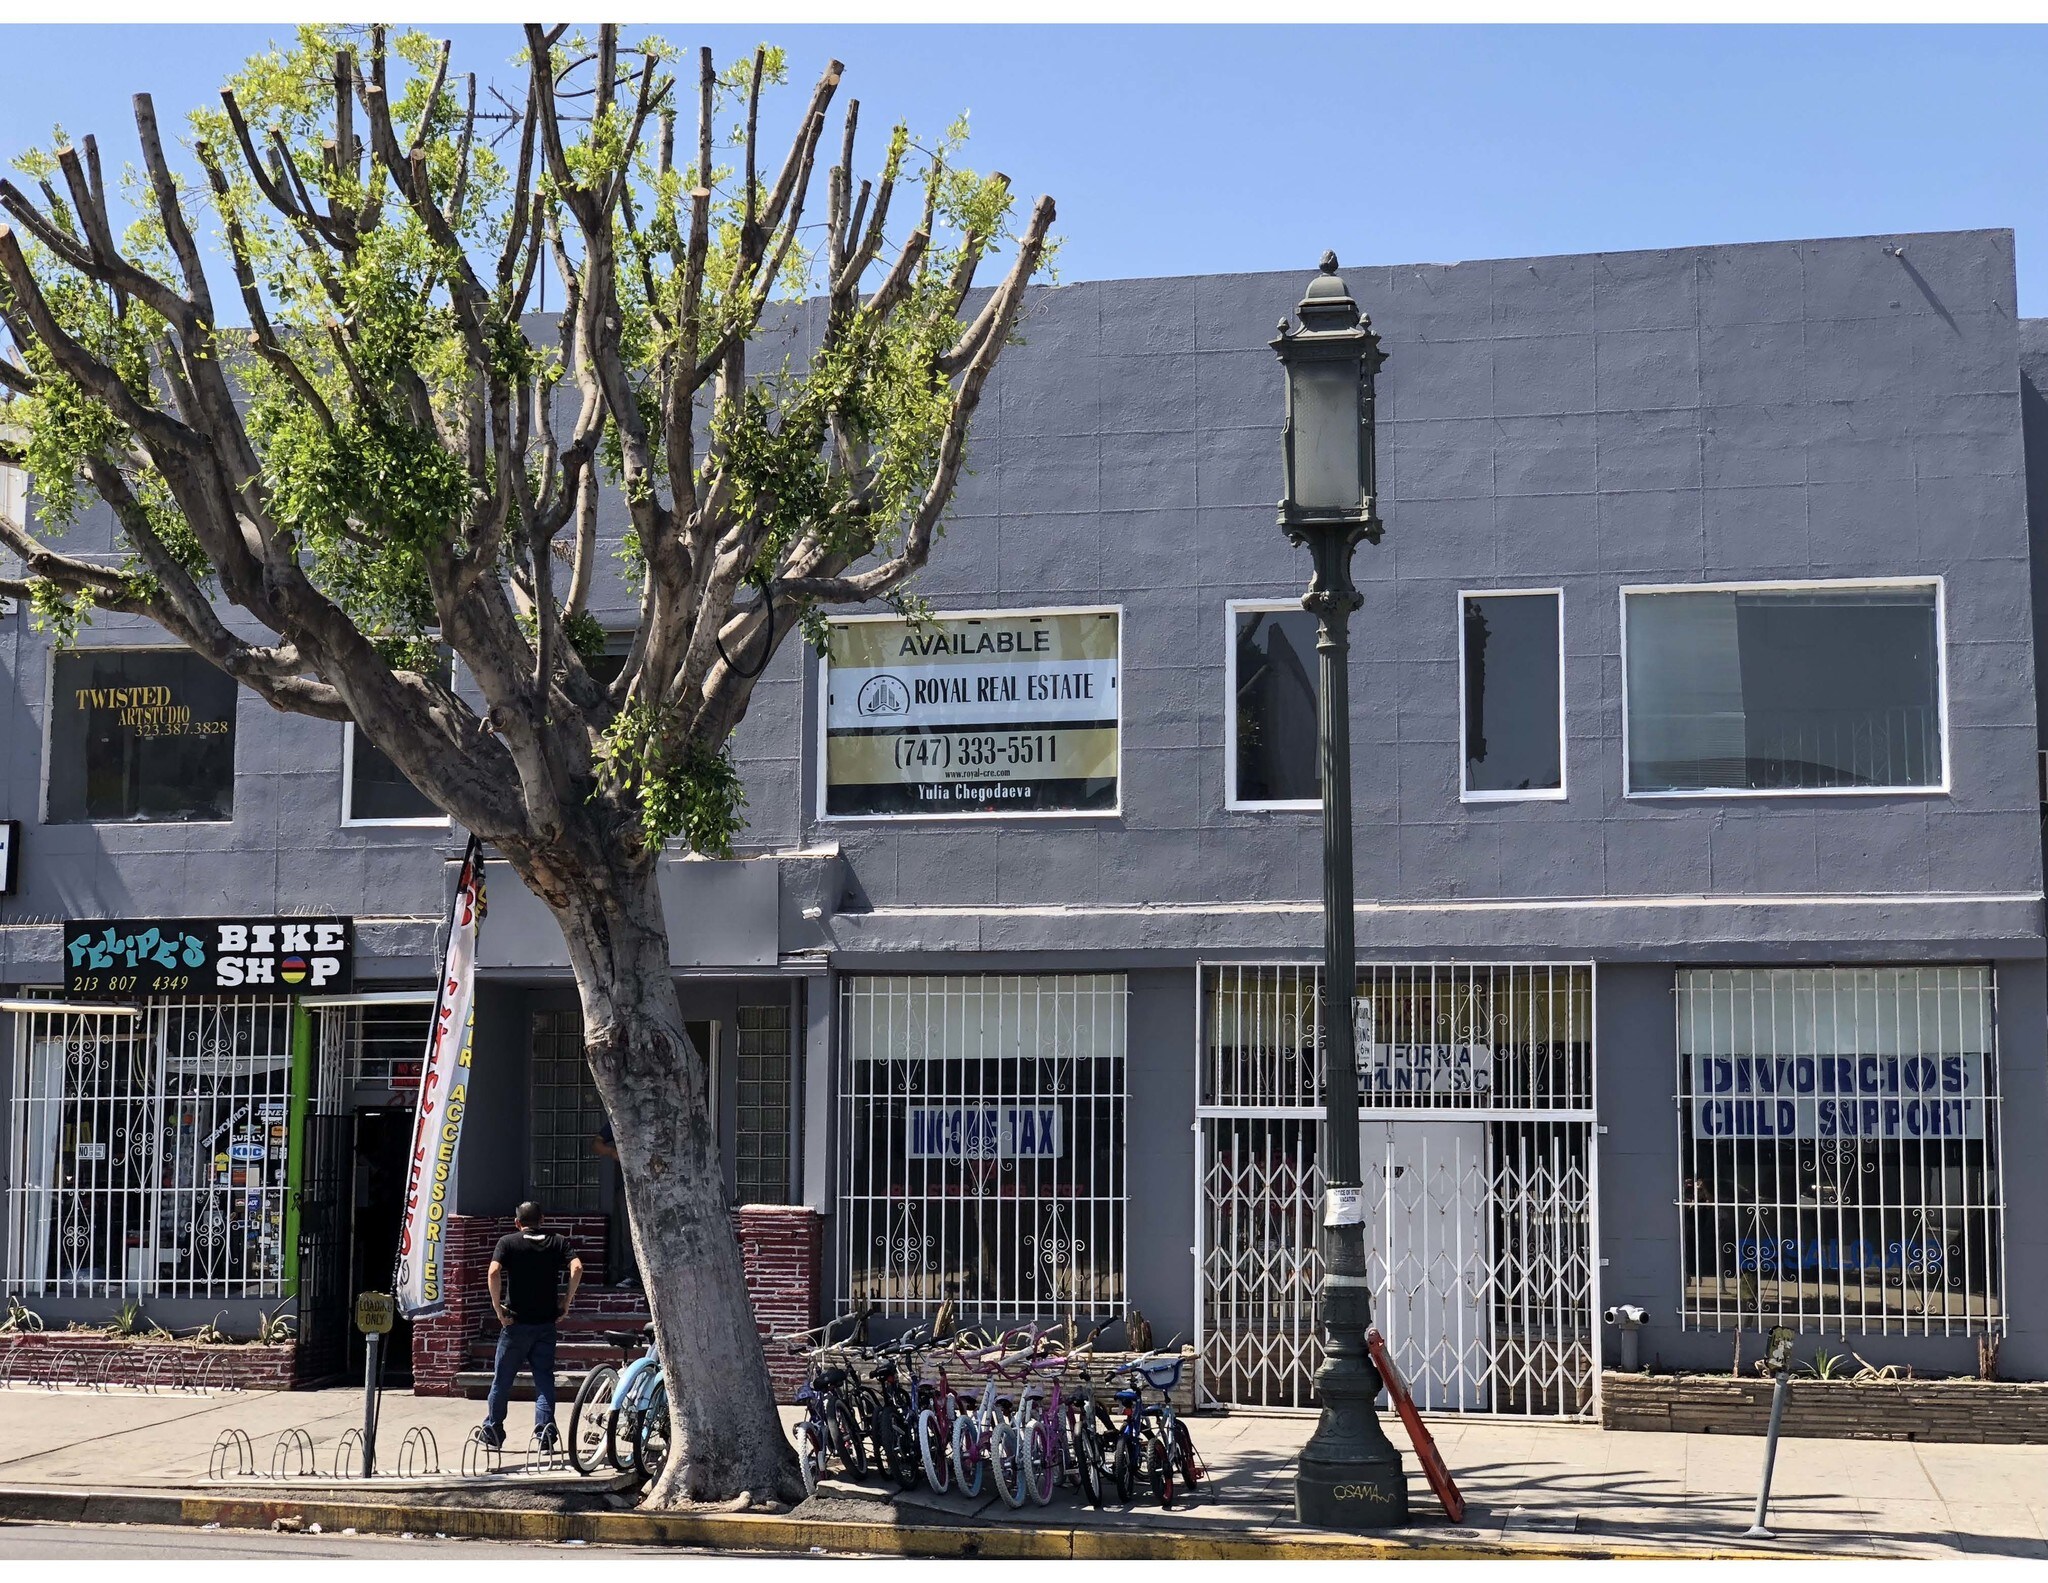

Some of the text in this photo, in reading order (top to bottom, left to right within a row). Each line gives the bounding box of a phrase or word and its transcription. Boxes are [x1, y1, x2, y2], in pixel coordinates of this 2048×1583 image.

[899, 630, 1050, 656] AVAILABLE
[75, 686, 172, 710] TWISTED
[914, 673, 1094, 704] ROYAL REAL ESTATE
[134, 721, 228, 737] 323.387.3828
[894, 735, 1056, 769] (747) 333-5511
[945, 768, 1011, 779] www.royal-cre.com
[918, 783, 1031, 802] Yulia Chegodaeva
[217, 924, 344, 953] BIKE
[73, 975, 189, 991] 213 807 4349
[1373, 1045, 1471, 1068] LIFORNIA
[1702, 1056, 1970, 1093] DIVORCIOS
[1702, 1100, 1971, 1136] CHILD SUPPORT
[231, 1134, 265, 1142] SURLY
[913, 1110, 1054, 1154] INCOME TAX
[79, 1146, 88, 1156] NO
[424, 1084, 466, 1301] ACCESSORIES
[365, 1313, 386, 1325] ONLY
